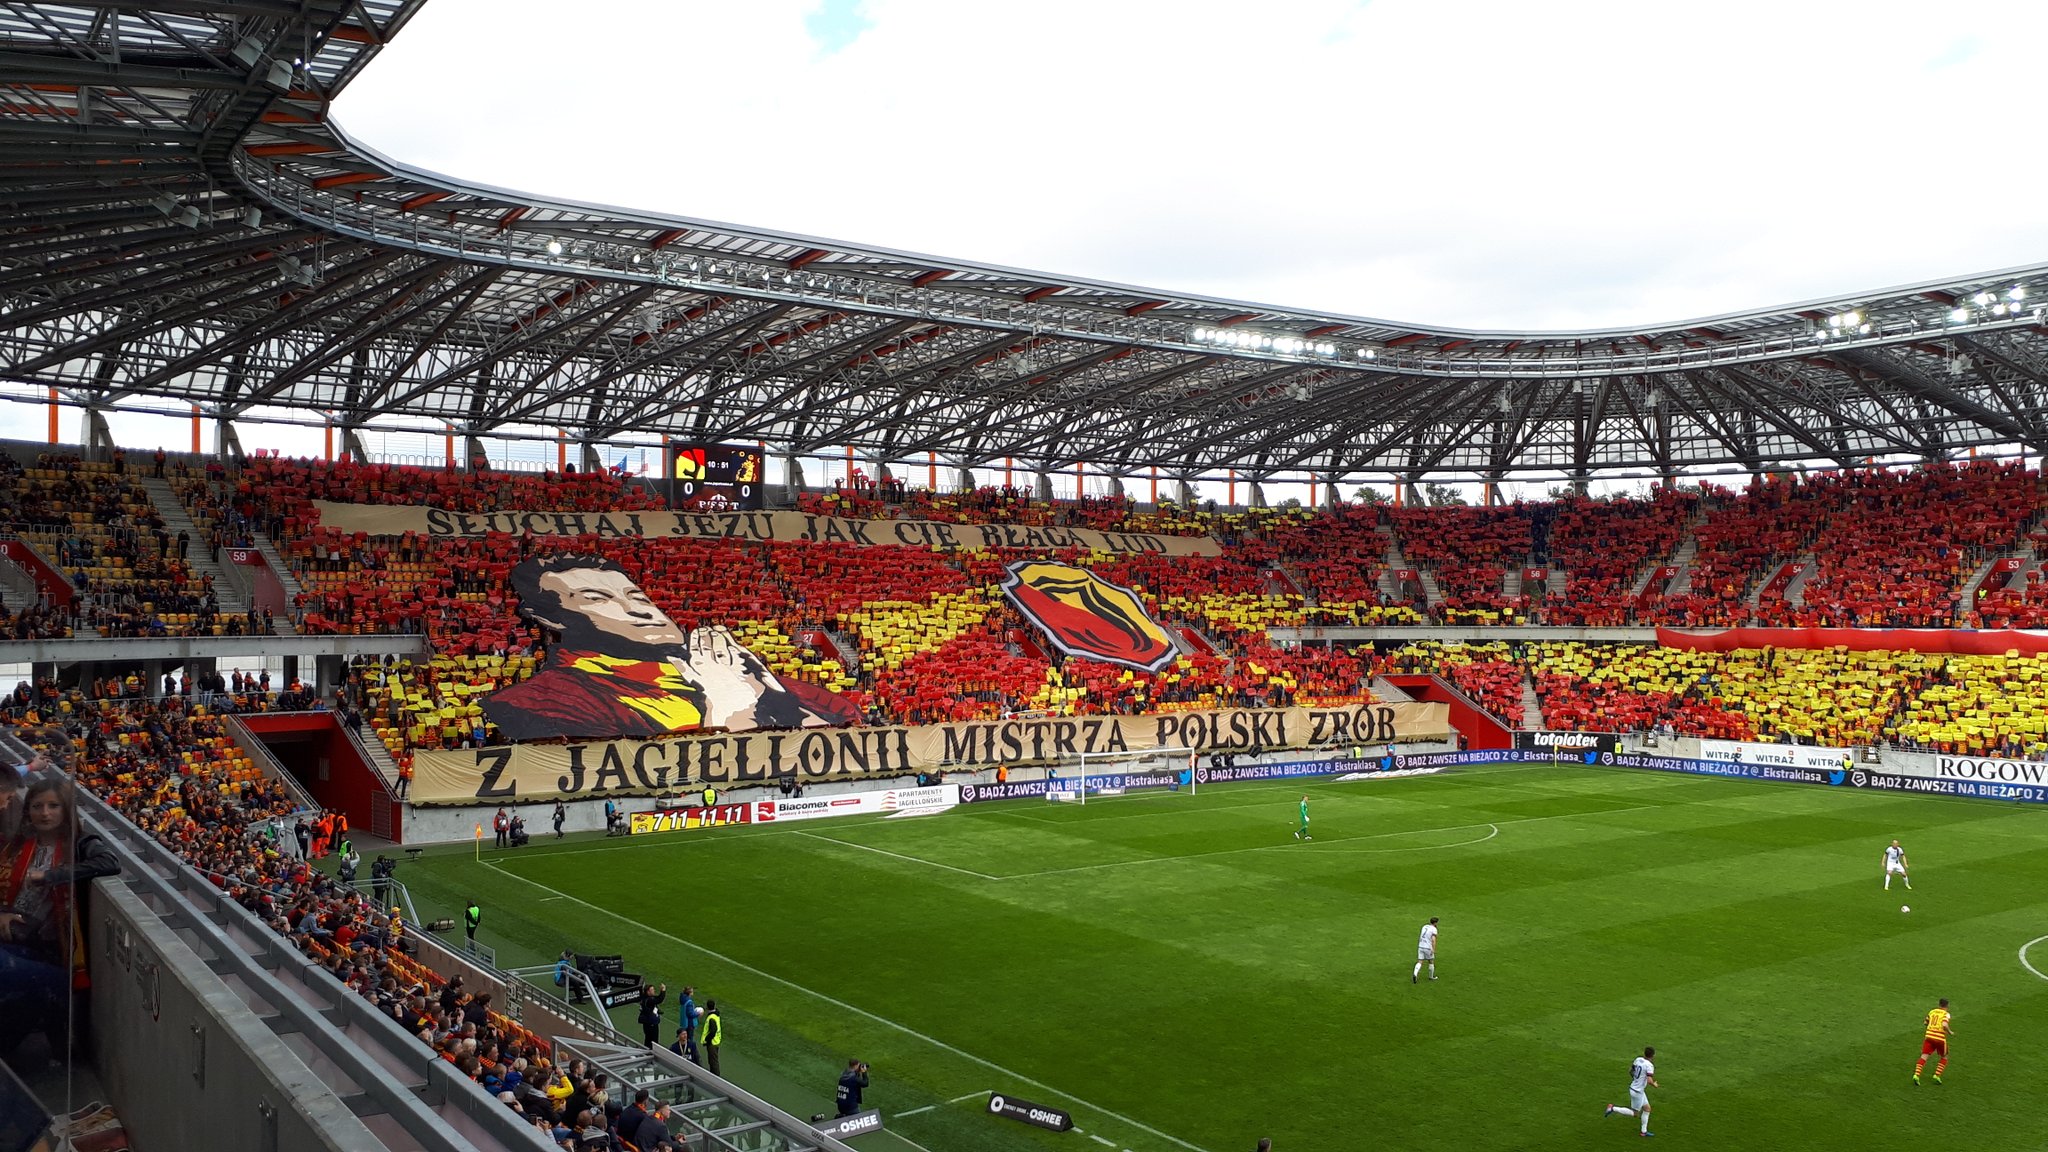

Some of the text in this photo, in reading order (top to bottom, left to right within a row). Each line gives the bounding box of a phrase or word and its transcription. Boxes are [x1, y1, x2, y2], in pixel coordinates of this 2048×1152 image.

[684, 482, 694, 494] 0
[742, 485, 750, 497] 0
[427, 509, 644, 538] SŁUCHAJ
[672, 514, 775, 540] JEZU
[801, 516, 876, 546] JAK
[976, 524, 1090, 548] BŁAGA
[1099, 533, 1167, 554] LUD
[233, 552, 246, 562] 59
[2008, 560, 2020, 569] 53
[804, 634, 814, 642] 27
[1534, 732, 1600, 748] totolotek
[475, 704, 1396, 798] Z JAGIELLONII MISTRZA POLSKI ZRÓB
[1408, 756, 1426, 768] BĄDŹ
[1428, 754, 1457, 766] ZAWSZE
[1458, 753, 1468, 763] NA
[1470, 751, 1500, 764] BIEŻĄCO
[1502, 752, 1508, 760] Z
[1211, 768, 1233, 782] BĄDŹ
[1234, 766, 1269, 778] ZAWSZE
[1270, 766, 1282, 776] NA
[1284, 763, 1316, 776] BIEŻĄCO
[1318, 763, 1324, 772] Z
[1616, 756, 1640, 768] BĄDŹ
[1642, 758, 1681, 770] ZAWSZE
[1684, 761, 1697, 772] NA
[1700, 762, 1740, 776] BIEŻĄCO
[1742, 766, 1748, 776] Z
[898, 788, 942, 798] APARTAMENTY
[1007, 781, 1046, 796] ZAWSZE
[1050, 781, 1063, 792] NA
[1105, 777, 1112, 788] Z
[1871, 776, 1902, 789] BĄDŹ
[1904, 778, 1954, 792] ZAWSZE
[1958, 784, 1976, 795] NA
[2036, 790, 2044, 800] Z
[778, 801, 828, 812] Biacomex
[653, 806, 742, 831] 7 11 11 11
[840, 1114, 878, 1132] OSHEE
[1030, 1108, 1062, 1126] OSHEE
